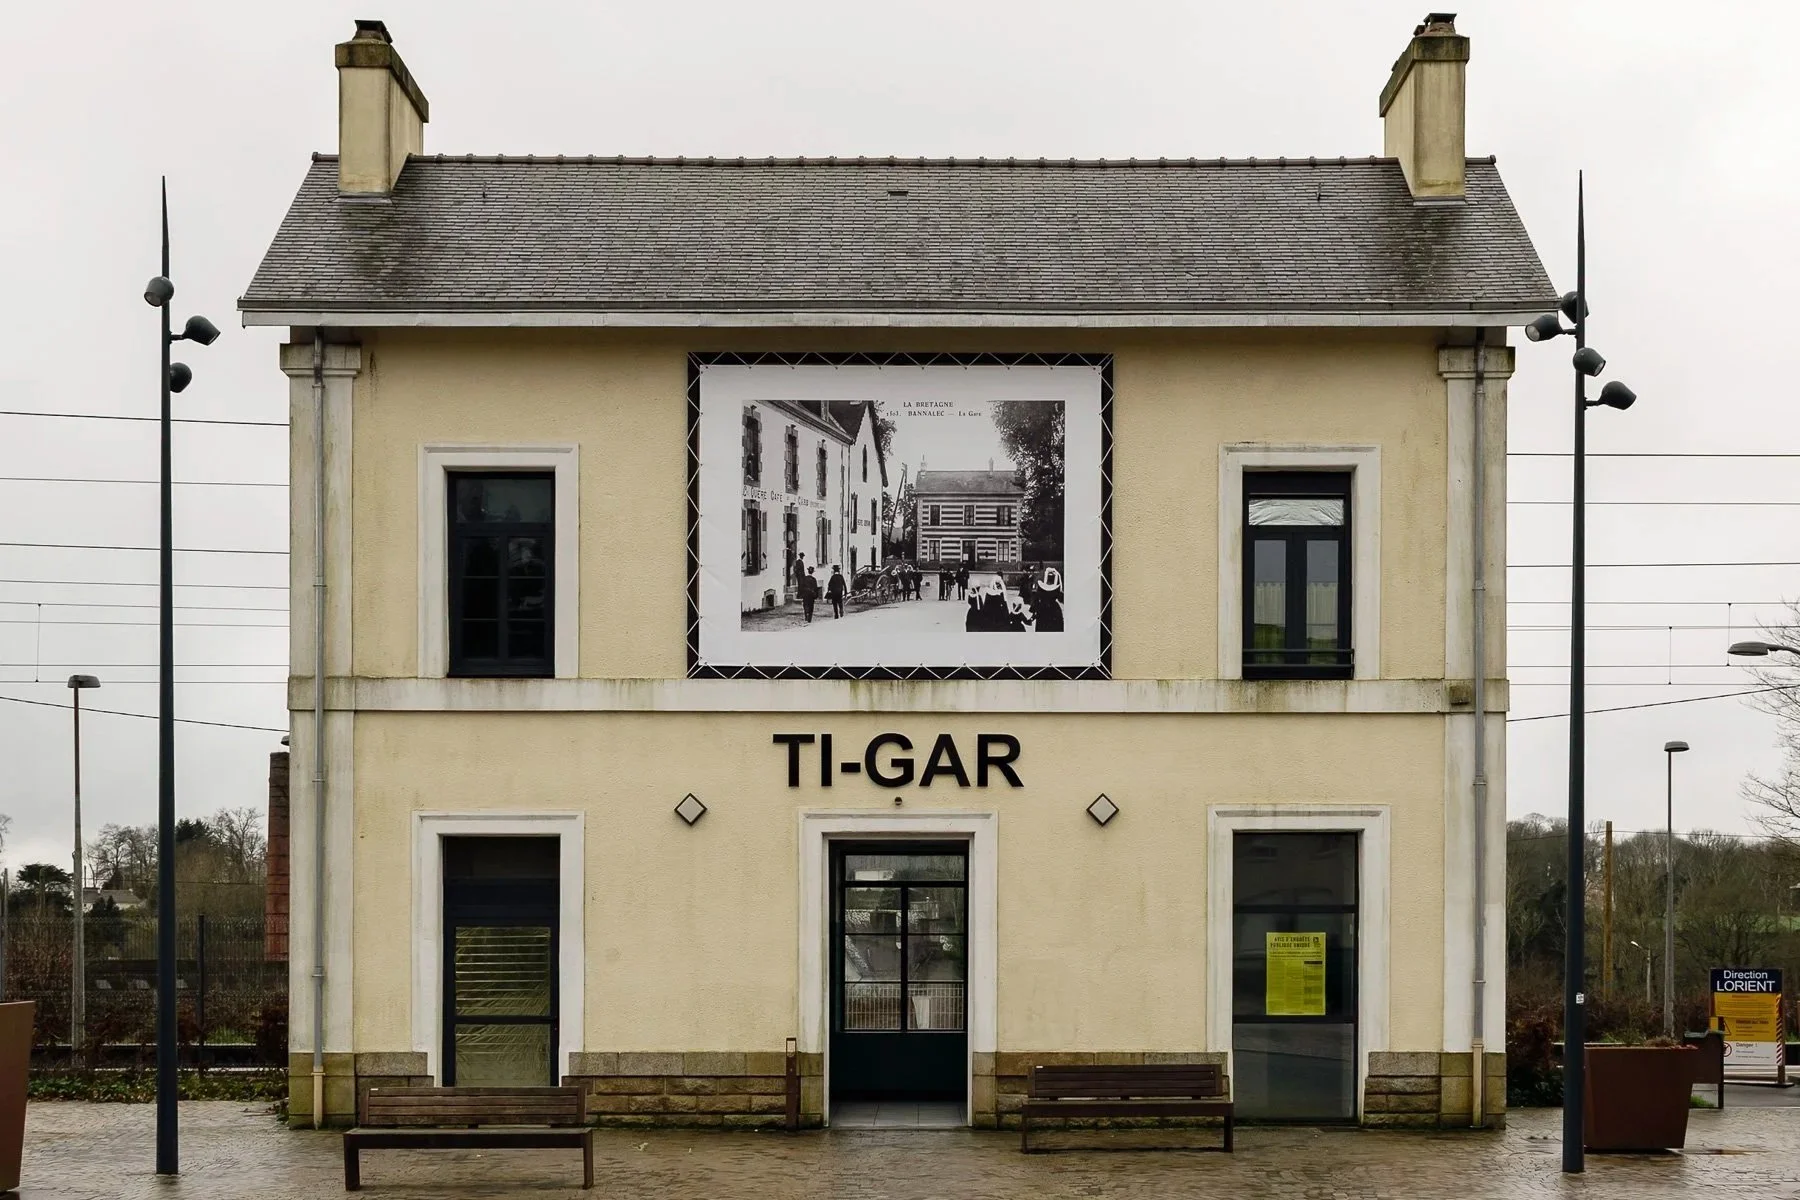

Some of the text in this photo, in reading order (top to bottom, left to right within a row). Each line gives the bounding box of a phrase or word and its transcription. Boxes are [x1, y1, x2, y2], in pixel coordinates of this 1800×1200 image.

[772, 732, 1025, 788] TI-GAR
[1723, 970, 1768, 979] Direction
[1716, 980, 1776, 992] LORIENT
